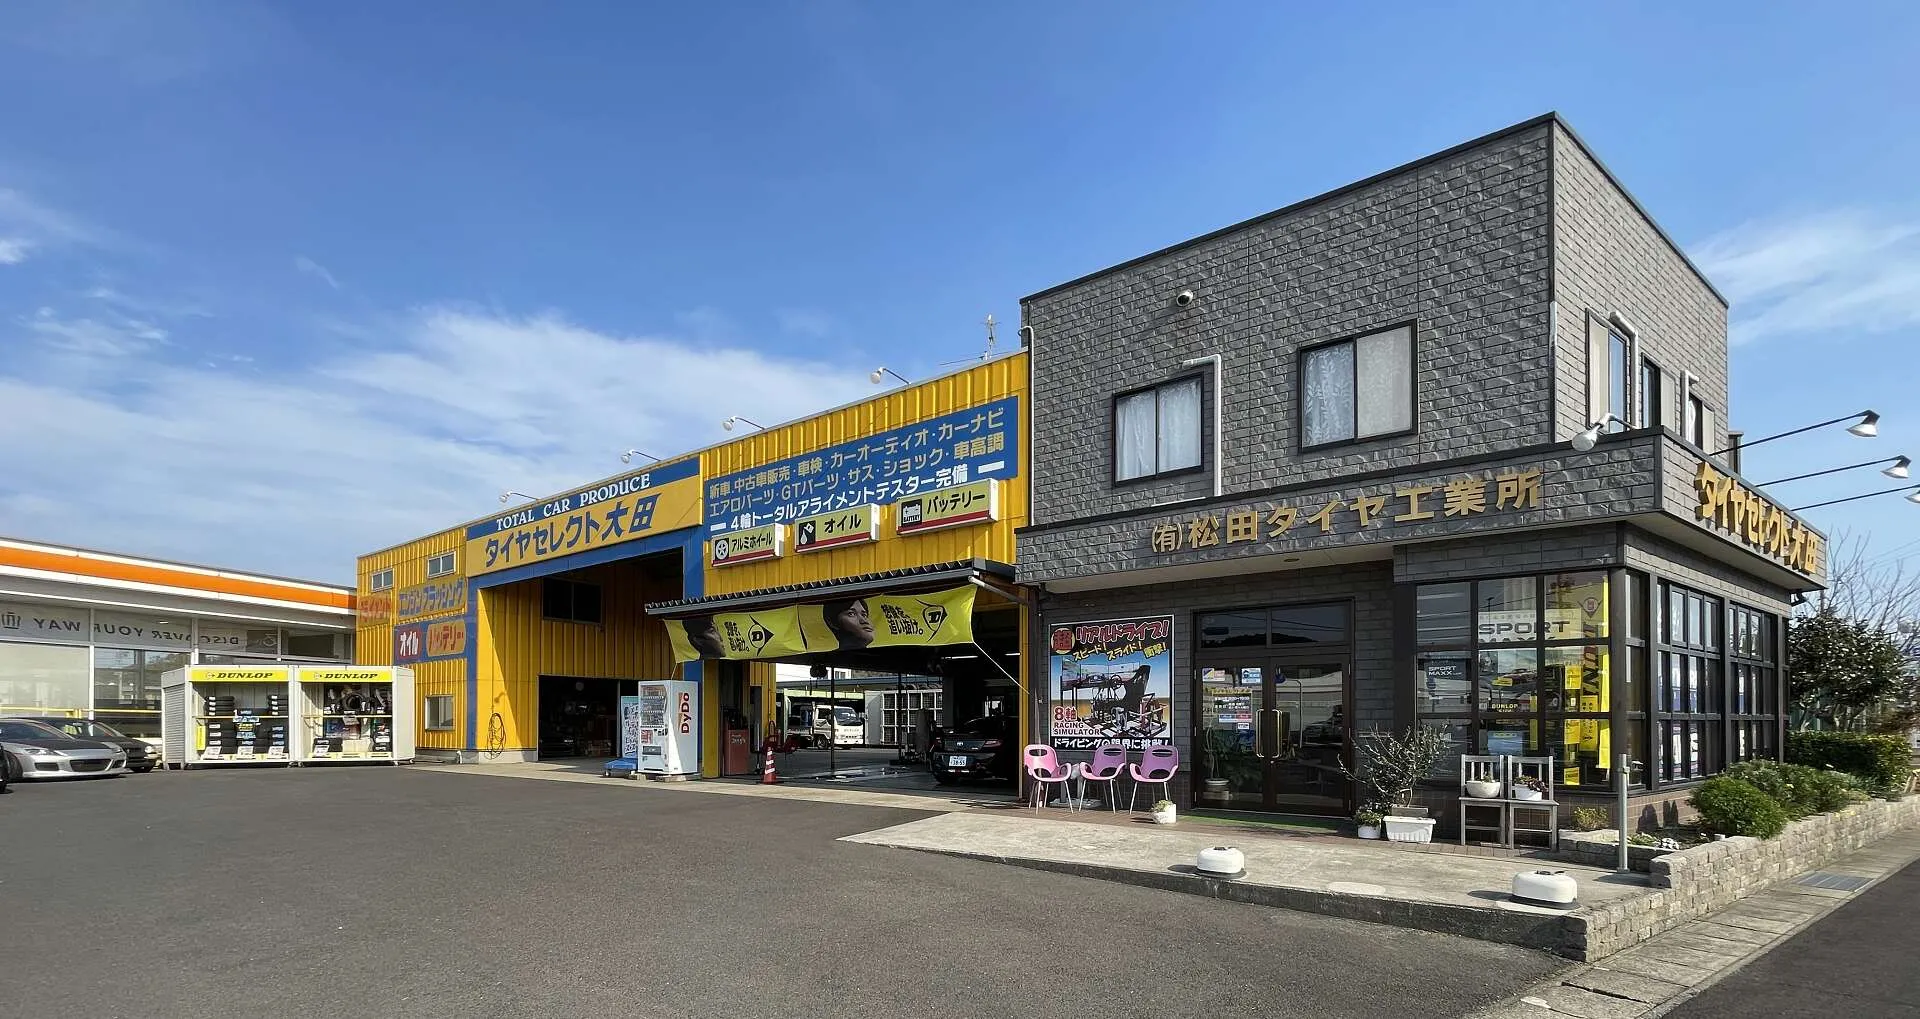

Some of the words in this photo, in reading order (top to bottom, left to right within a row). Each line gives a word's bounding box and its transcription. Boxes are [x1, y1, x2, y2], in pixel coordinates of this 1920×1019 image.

[496, 511, 535, 531] TOTAL
[543, 498, 571, 517] CAR
[579, 473, 650, 508] PRODUCE
[926, 490, 986, 515] バッテリー
[823, 513, 862, 534] オイル
[1695, 461, 1818, 575] タイヤセレクト大田
[485, 492, 662, 568] タイヤセレクト大田
[731, 531, 773, 553] アルミホイール
[1478, 619, 1571, 635] SPORT
[400, 630, 419, 657] オイル
[1052, 629, 1073, 651] 超
[681, 692, 691, 734] DyDo
[1054, 706, 1078, 722] 8軸
[1053, 728, 1101, 736] SIMULATOR
